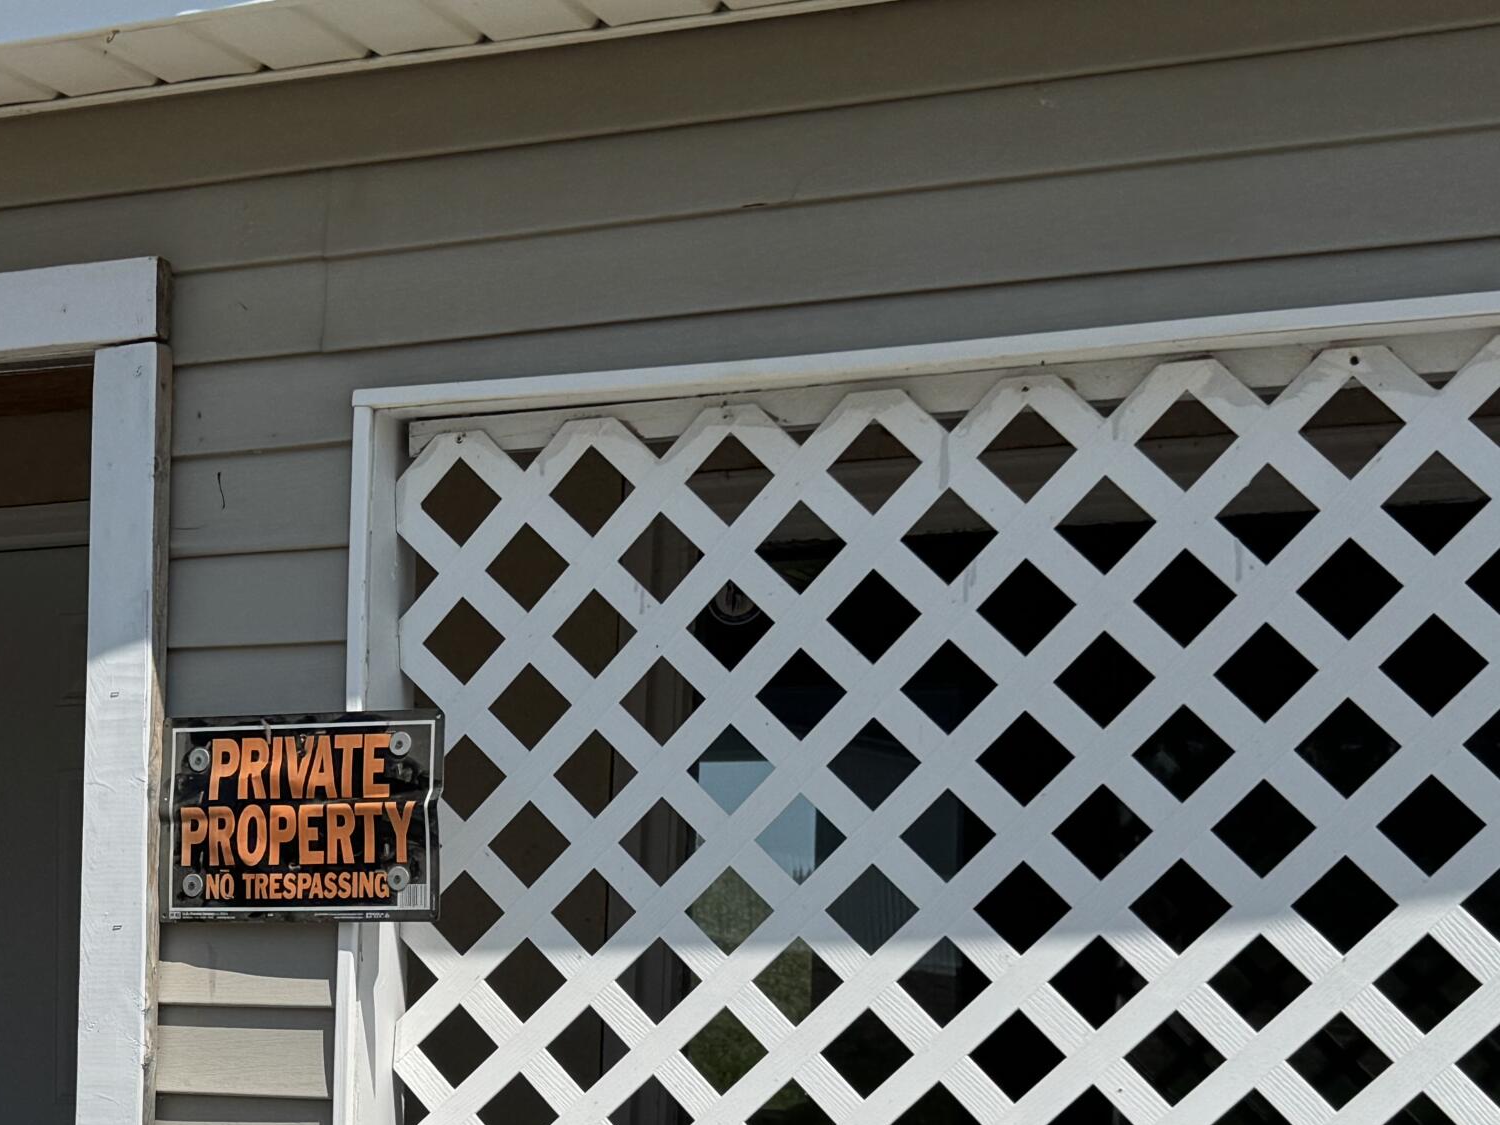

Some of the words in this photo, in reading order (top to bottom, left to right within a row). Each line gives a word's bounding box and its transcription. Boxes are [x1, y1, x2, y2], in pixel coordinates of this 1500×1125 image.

[208, 734, 392, 801] PRIVATE
[180, 801, 416, 867] PROPERTY
[205, 873, 235, 899] NO
[242, 871, 390, 899] TRESPASSING
